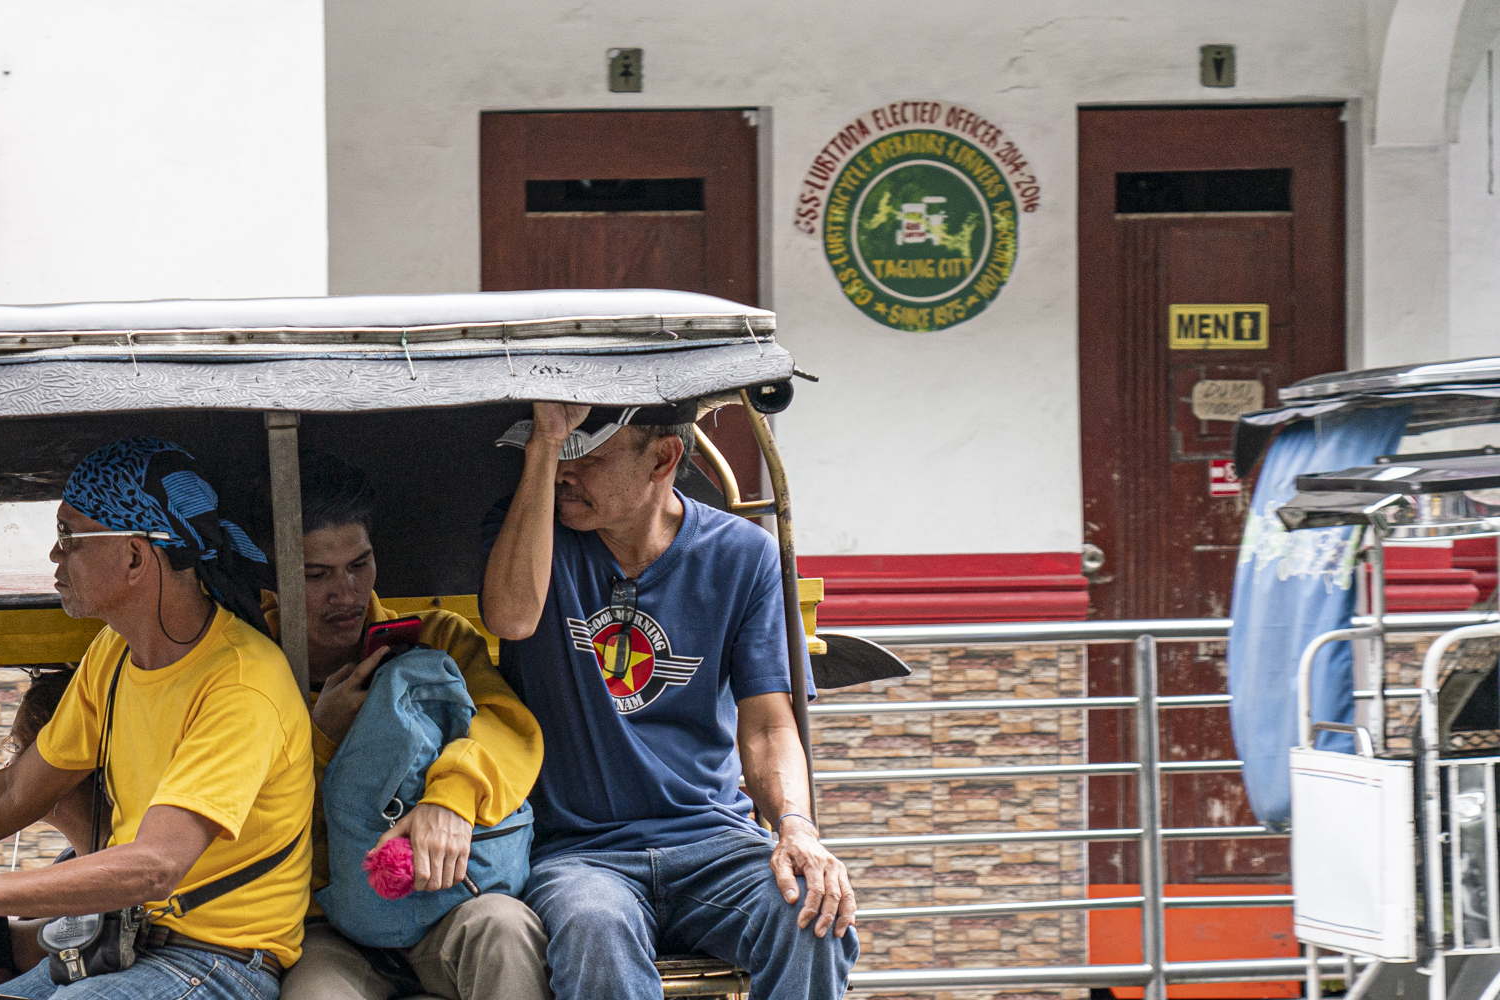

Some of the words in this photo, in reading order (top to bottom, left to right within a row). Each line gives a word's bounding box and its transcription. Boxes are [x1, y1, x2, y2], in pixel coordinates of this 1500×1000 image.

[871, 101, 942, 130] ELECTED
[871, 258, 936, 279] TAGUIG
[938, 257, 973, 279] CITY
[1177, 313, 1229, 339] MEN
